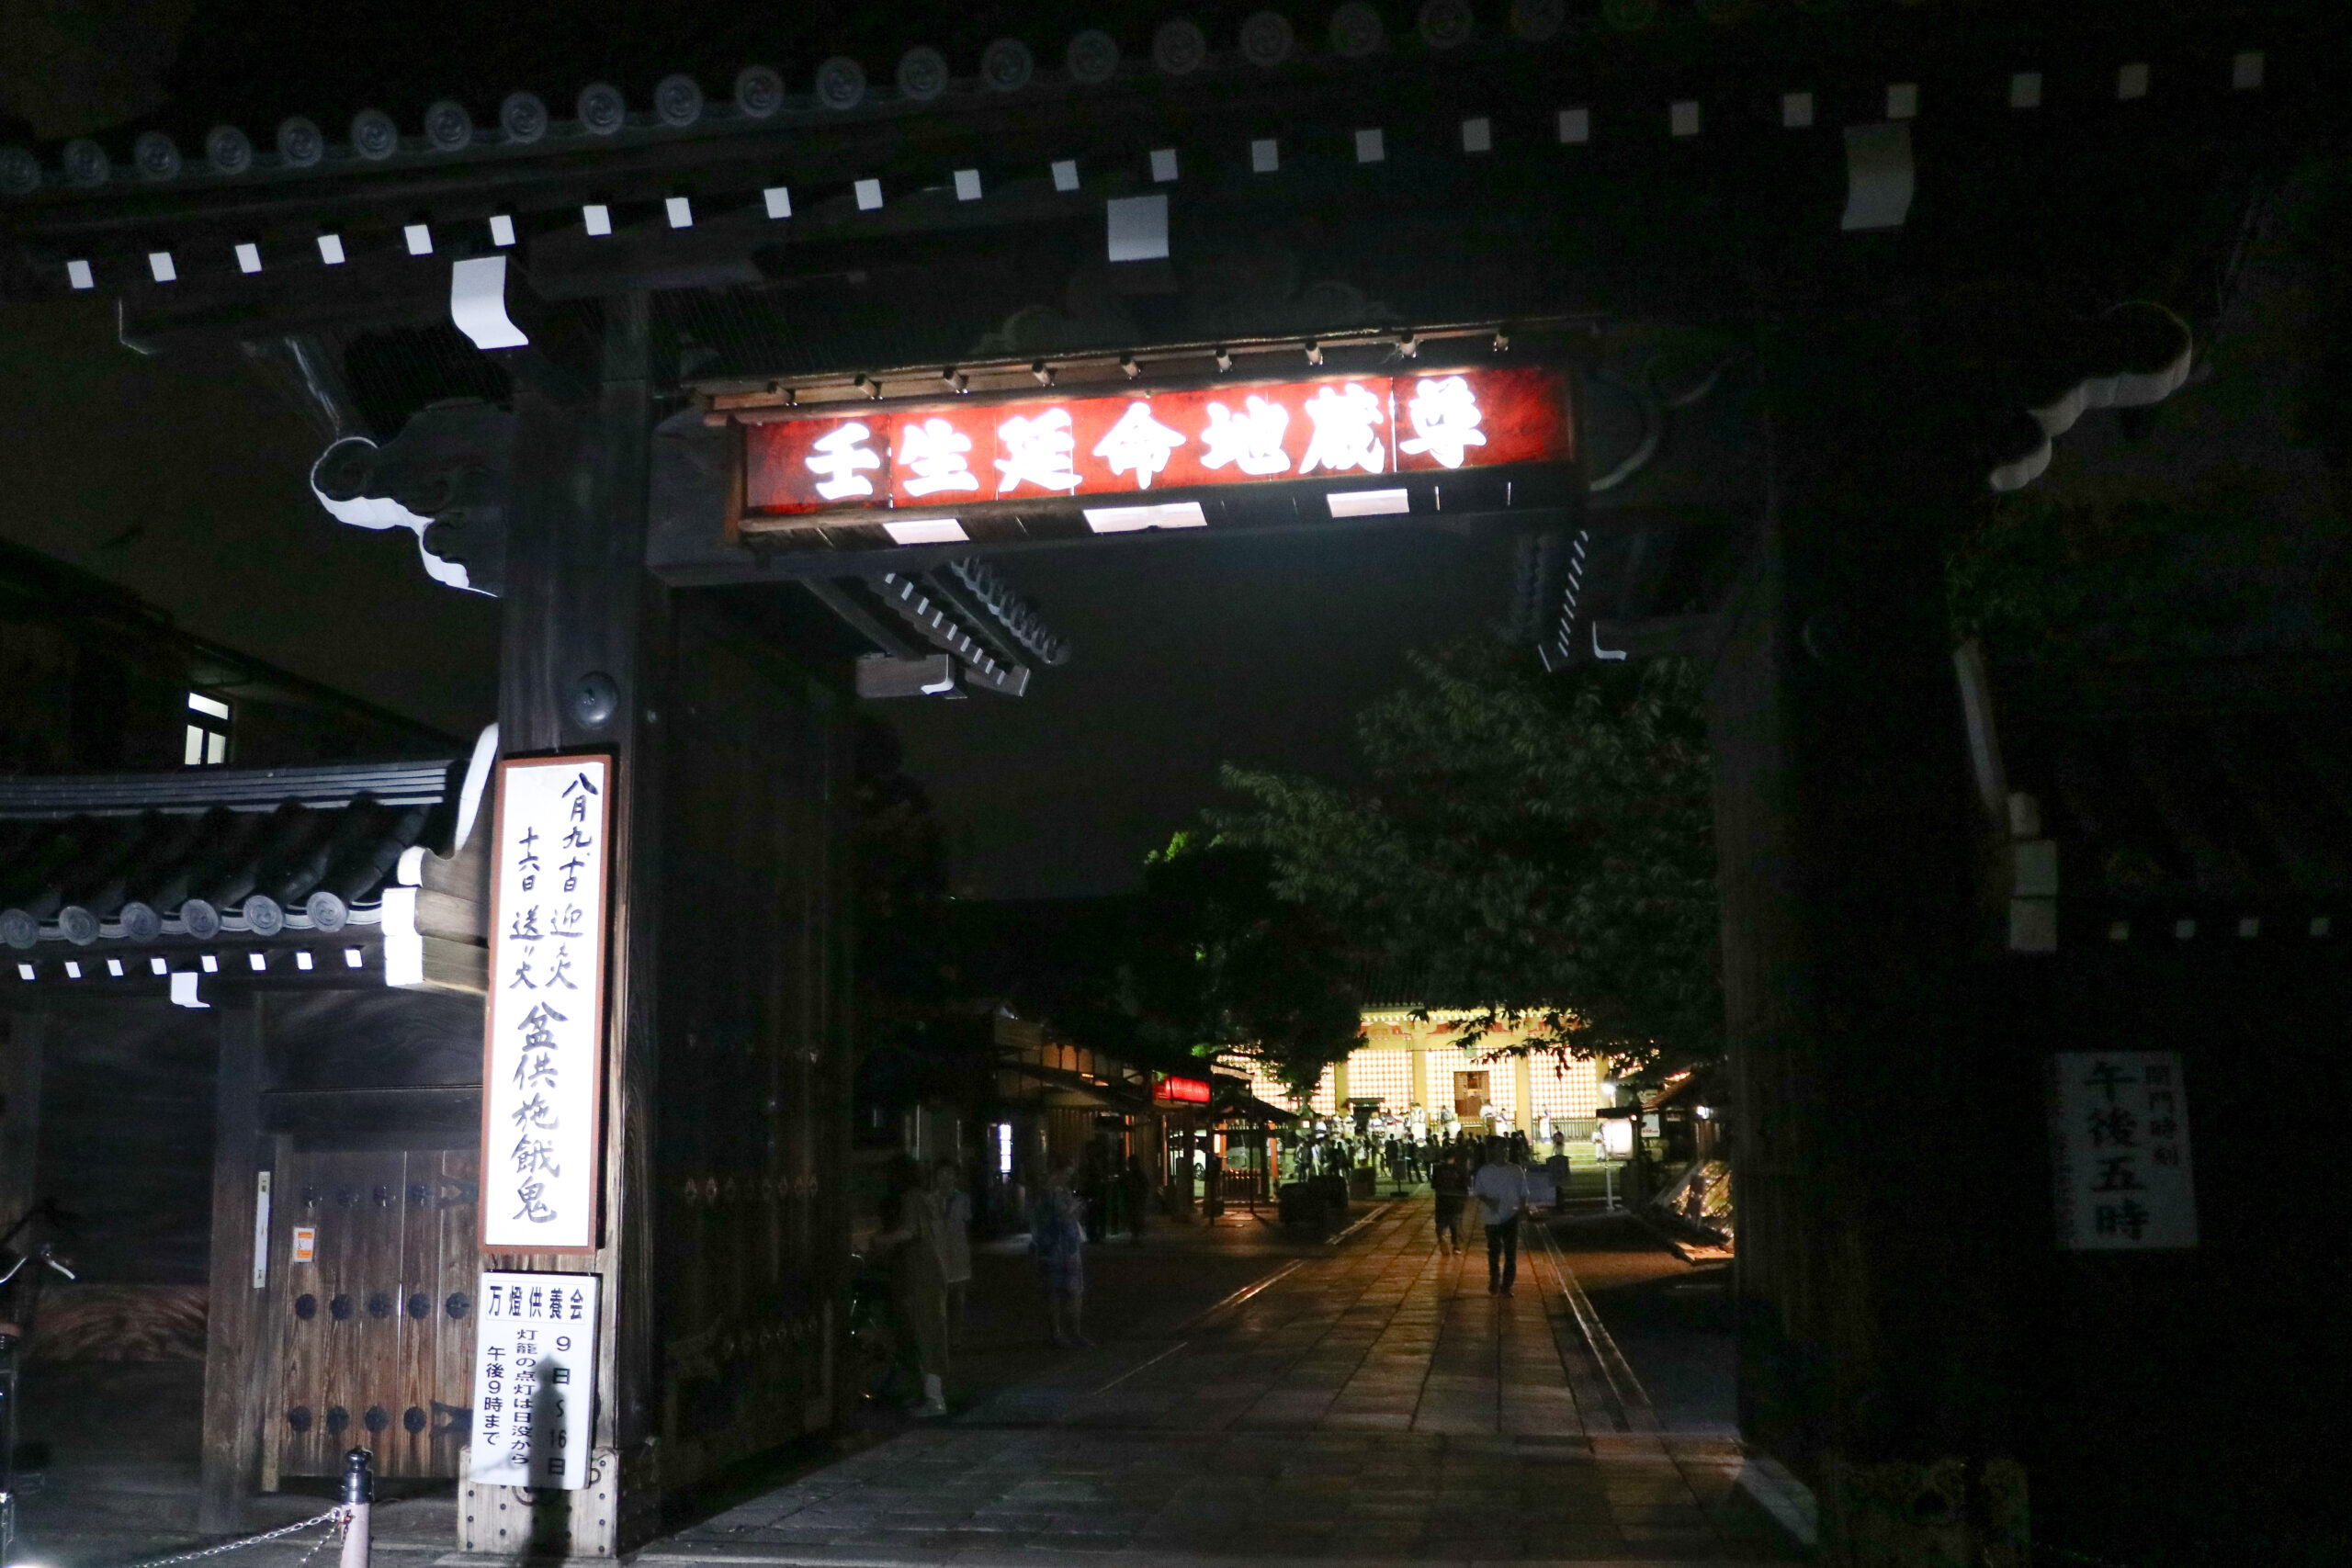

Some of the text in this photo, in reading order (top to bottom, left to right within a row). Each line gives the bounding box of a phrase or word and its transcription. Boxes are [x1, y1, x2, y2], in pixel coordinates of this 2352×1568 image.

[488, 1285, 584, 1321] 万燈供養会
[482, 1346, 507, 1446] 午後9時まで
